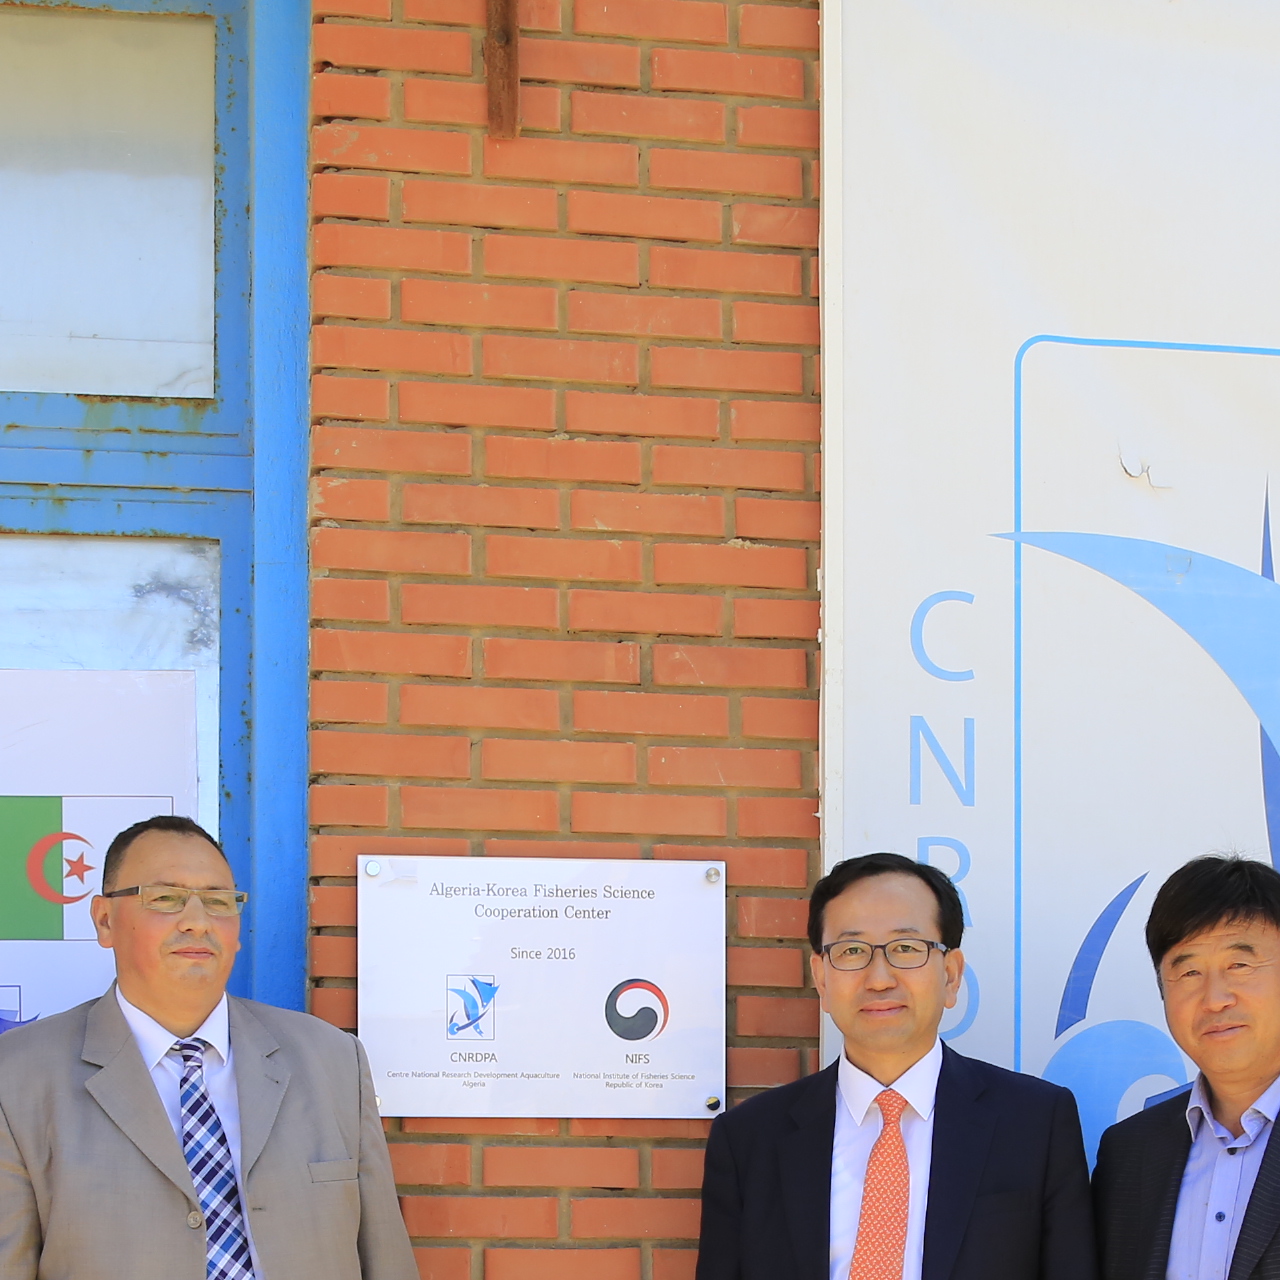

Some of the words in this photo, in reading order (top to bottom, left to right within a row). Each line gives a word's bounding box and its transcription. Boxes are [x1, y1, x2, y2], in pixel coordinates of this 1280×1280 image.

[429, 882, 528, 898] Algeria-Korea
[533, 884, 598, 899] Fisheries
[603, 884, 656, 900] Science
[474, 903, 559, 921] Cooperation
[564, 905, 612, 920] Center
[510, 947, 542, 960] Since
[546, 947, 576, 960] 2016
[450, 1051, 498, 1063] CNRDPA
[625, 1053, 650, 1065] NIFS
[386, 1070, 409, 1079] Centre
[411, 1070, 440, 1079] National
[441, 1070, 472, 1079] Research
[474, 1071, 519, 1081] Development
[520, 1071, 561, 1081] Aquaculture
[573, 1072, 601, 1080] National
[602, 1072, 630, 1080] Institute
[631, 1072, 640, 1080] of
[641, 1072, 669, 1081] Fisheries
[671, 1072, 696, 1081] Science
[462, 1080, 486, 1089] Algeria
[605, 1081, 634, 1090] Republic
[635, 1081, 643, 1089] of
[644, 1081, 664, 1090] Korea
